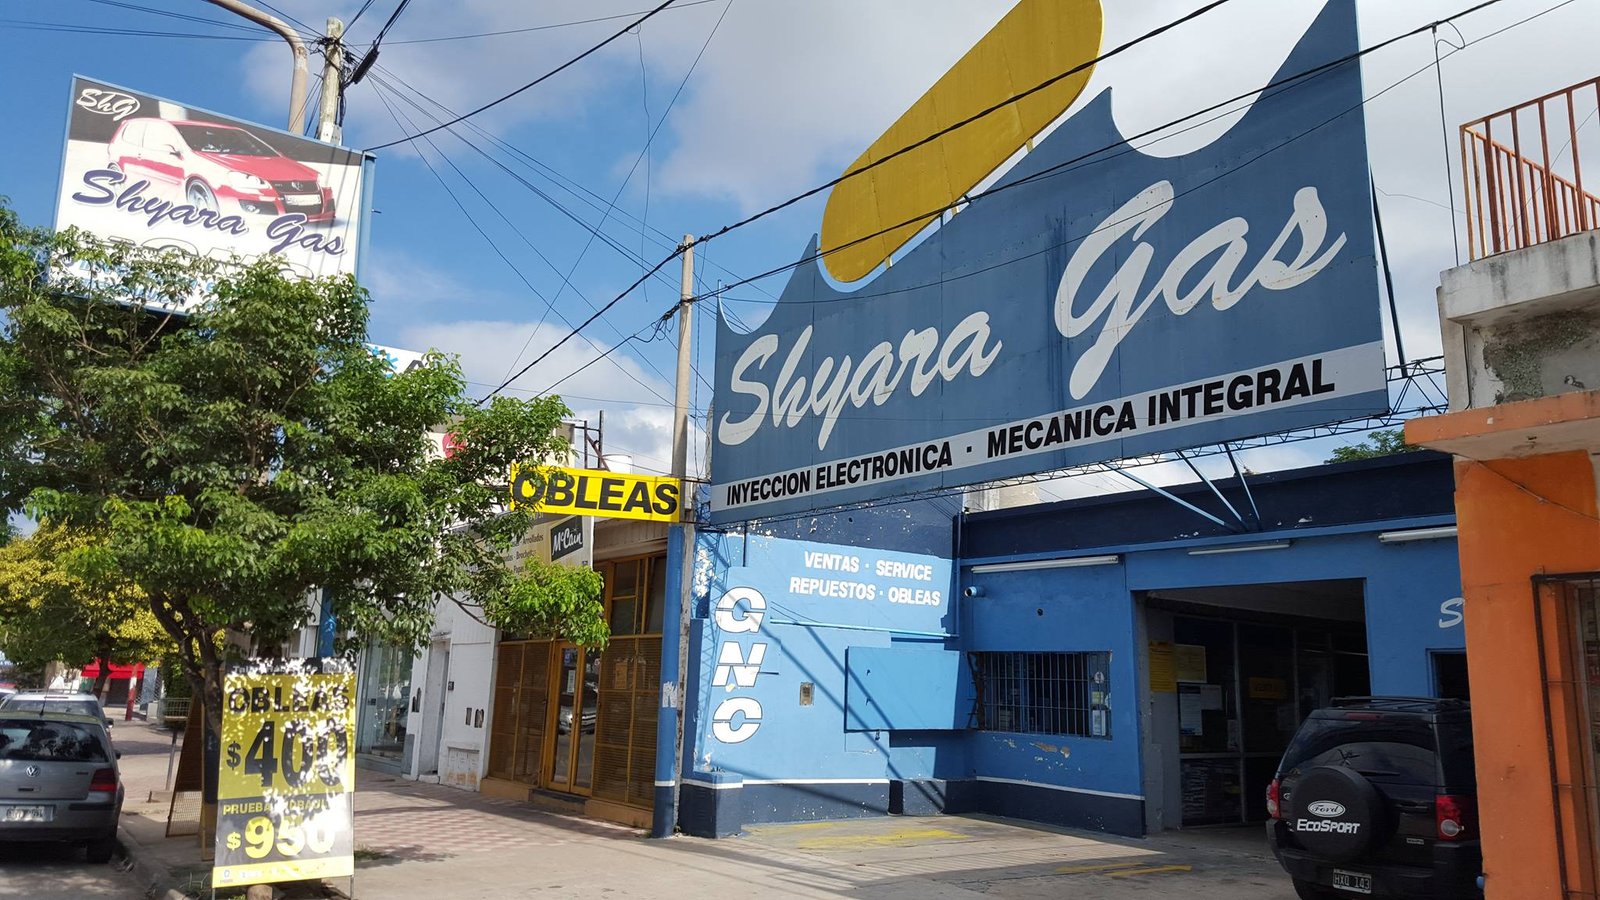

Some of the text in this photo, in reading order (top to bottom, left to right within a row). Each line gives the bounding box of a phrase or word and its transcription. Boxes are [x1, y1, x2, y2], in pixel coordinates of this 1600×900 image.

[72, 169, 345, 256] Shyara Gas
[717, 179, 1346, 450] Shyara Gas
[726, 358, 1335, 506] INYECCION ELECTRONICA MECANICA INTEGRAL
[511, 470, 680, 516] OBLEAS
[803, 550, 932, 581] VENTAS SERVICE
[789, 576, 941, 606] REPUESTOS OBLEAS
[711, 586, 768, 744] GNC
[228, 685, 350, 713] OBLEAS
[222, 801, 272, 816] PRUEBA
[1311, 803, 1340, 814] Ford
